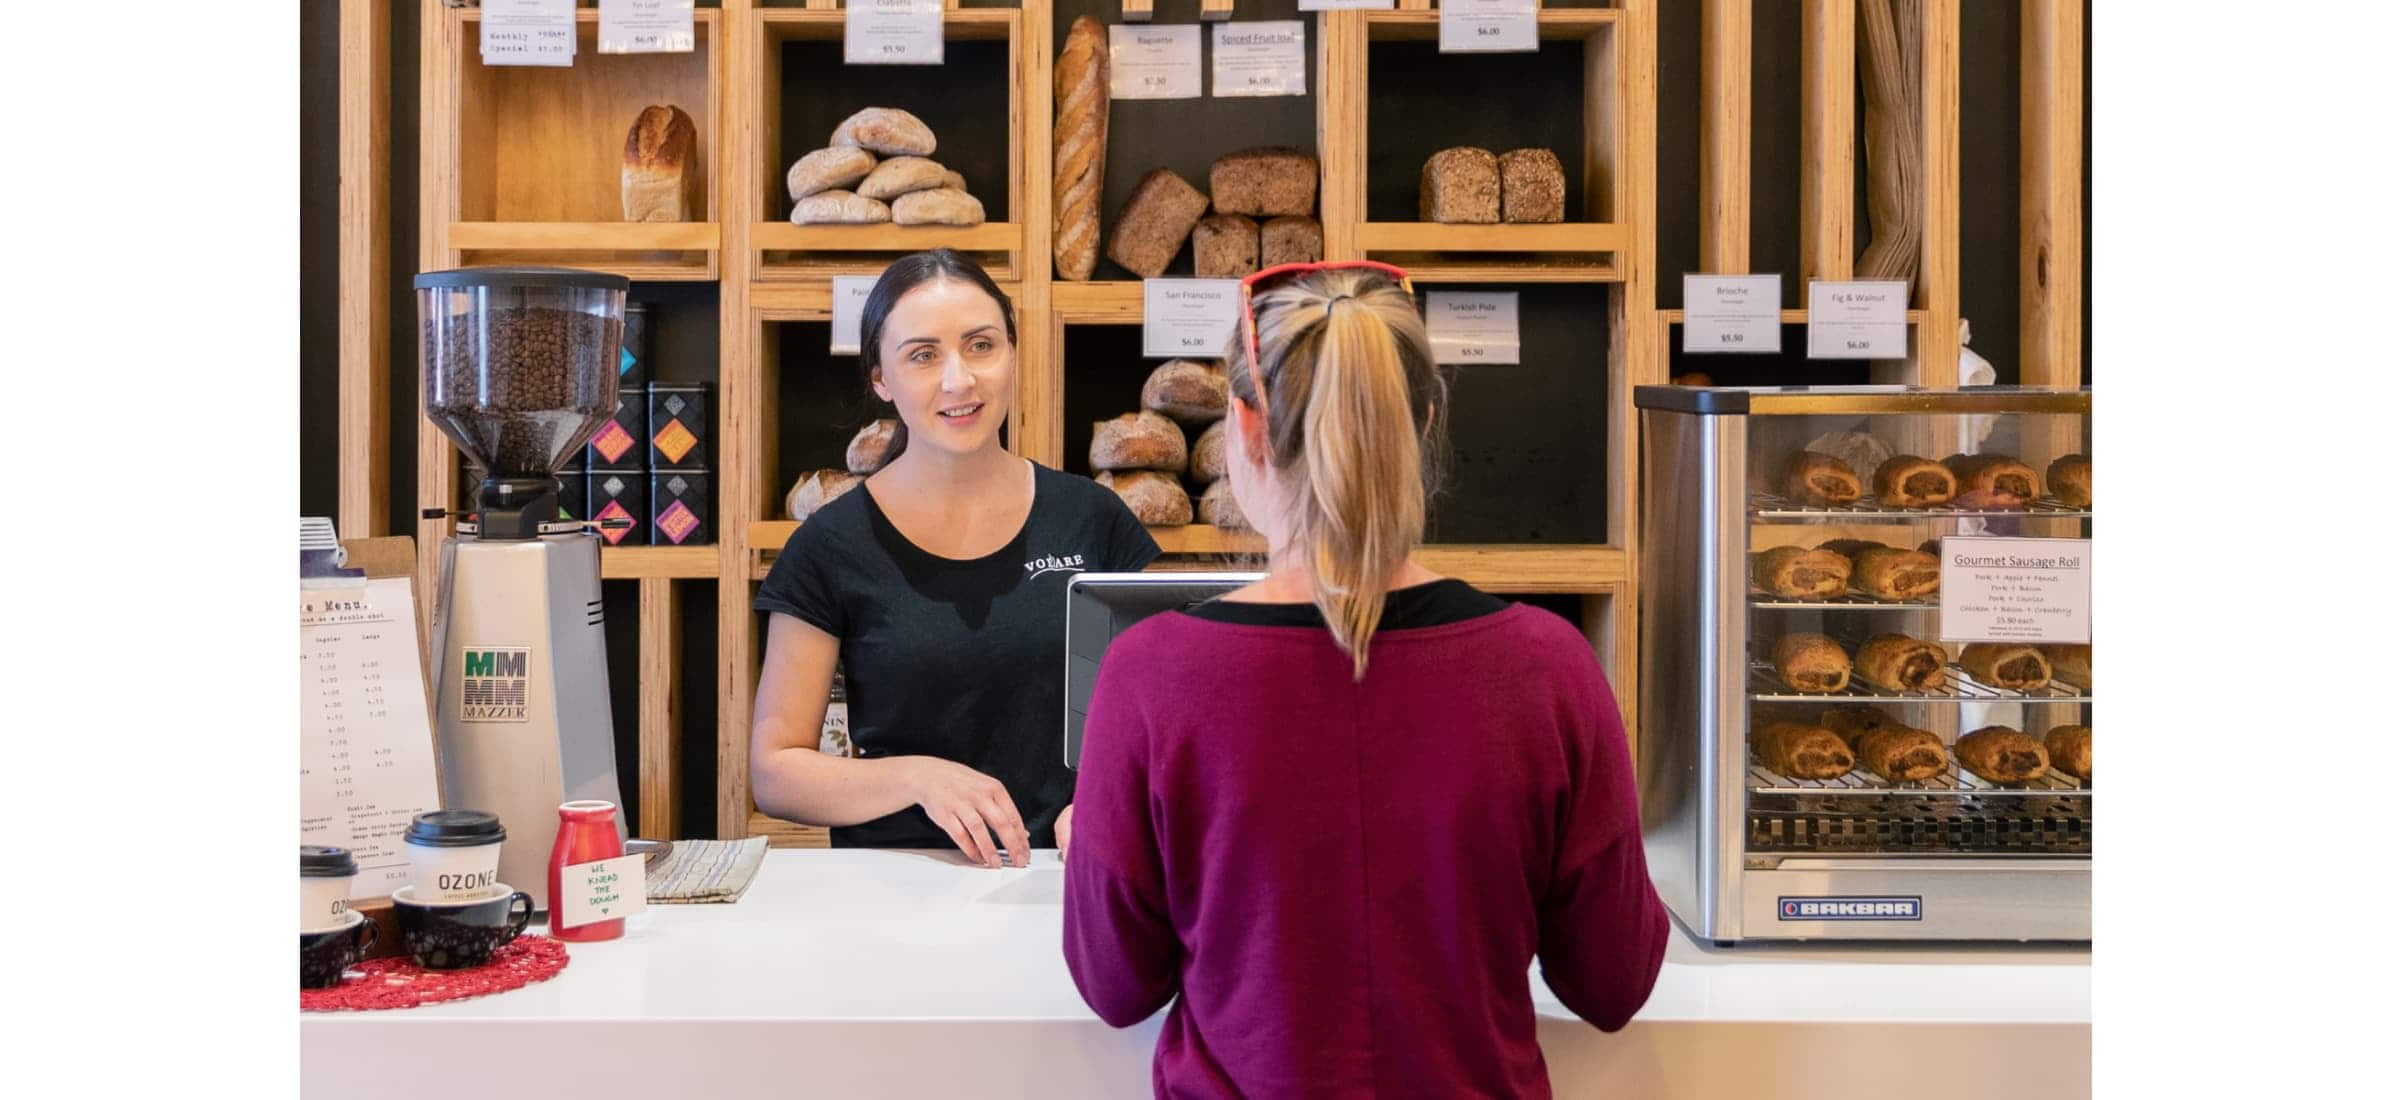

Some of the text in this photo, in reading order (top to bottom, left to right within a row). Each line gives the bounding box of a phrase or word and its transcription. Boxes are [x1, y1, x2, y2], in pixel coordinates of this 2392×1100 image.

[1221, 34, 1252, 46] Spiced
[1253, 33, 1275, 44] Fruit
[1165, 290, 1222, 300] San Francisco
[1716, 286, 1749, 296] Brioche
[1831, 294, 1886, 304] Fig & Walnut
[1447, 302, 1478, 312] Turkish
[1181, 338, 1205, 347] $6.00
[1846, 341, 1870, 350] $6.00
[1954, 554, 2080, 569] Gourmet Sausage Roll
[325, 600, 368, 612] Menu.
[464, 707, 526, 718] MAZZER
[591, 863, 605, 873] WE
[439, 869, 494, 890] OZONE
[588, 873, 618, 885] KNEAD
[594, 885, 610, 894] THE
[589, 894, 619, 906] DOUGH
[331, 898, 351, 915] OZ
[1800, 902, 1914, 916] BAKBAR
